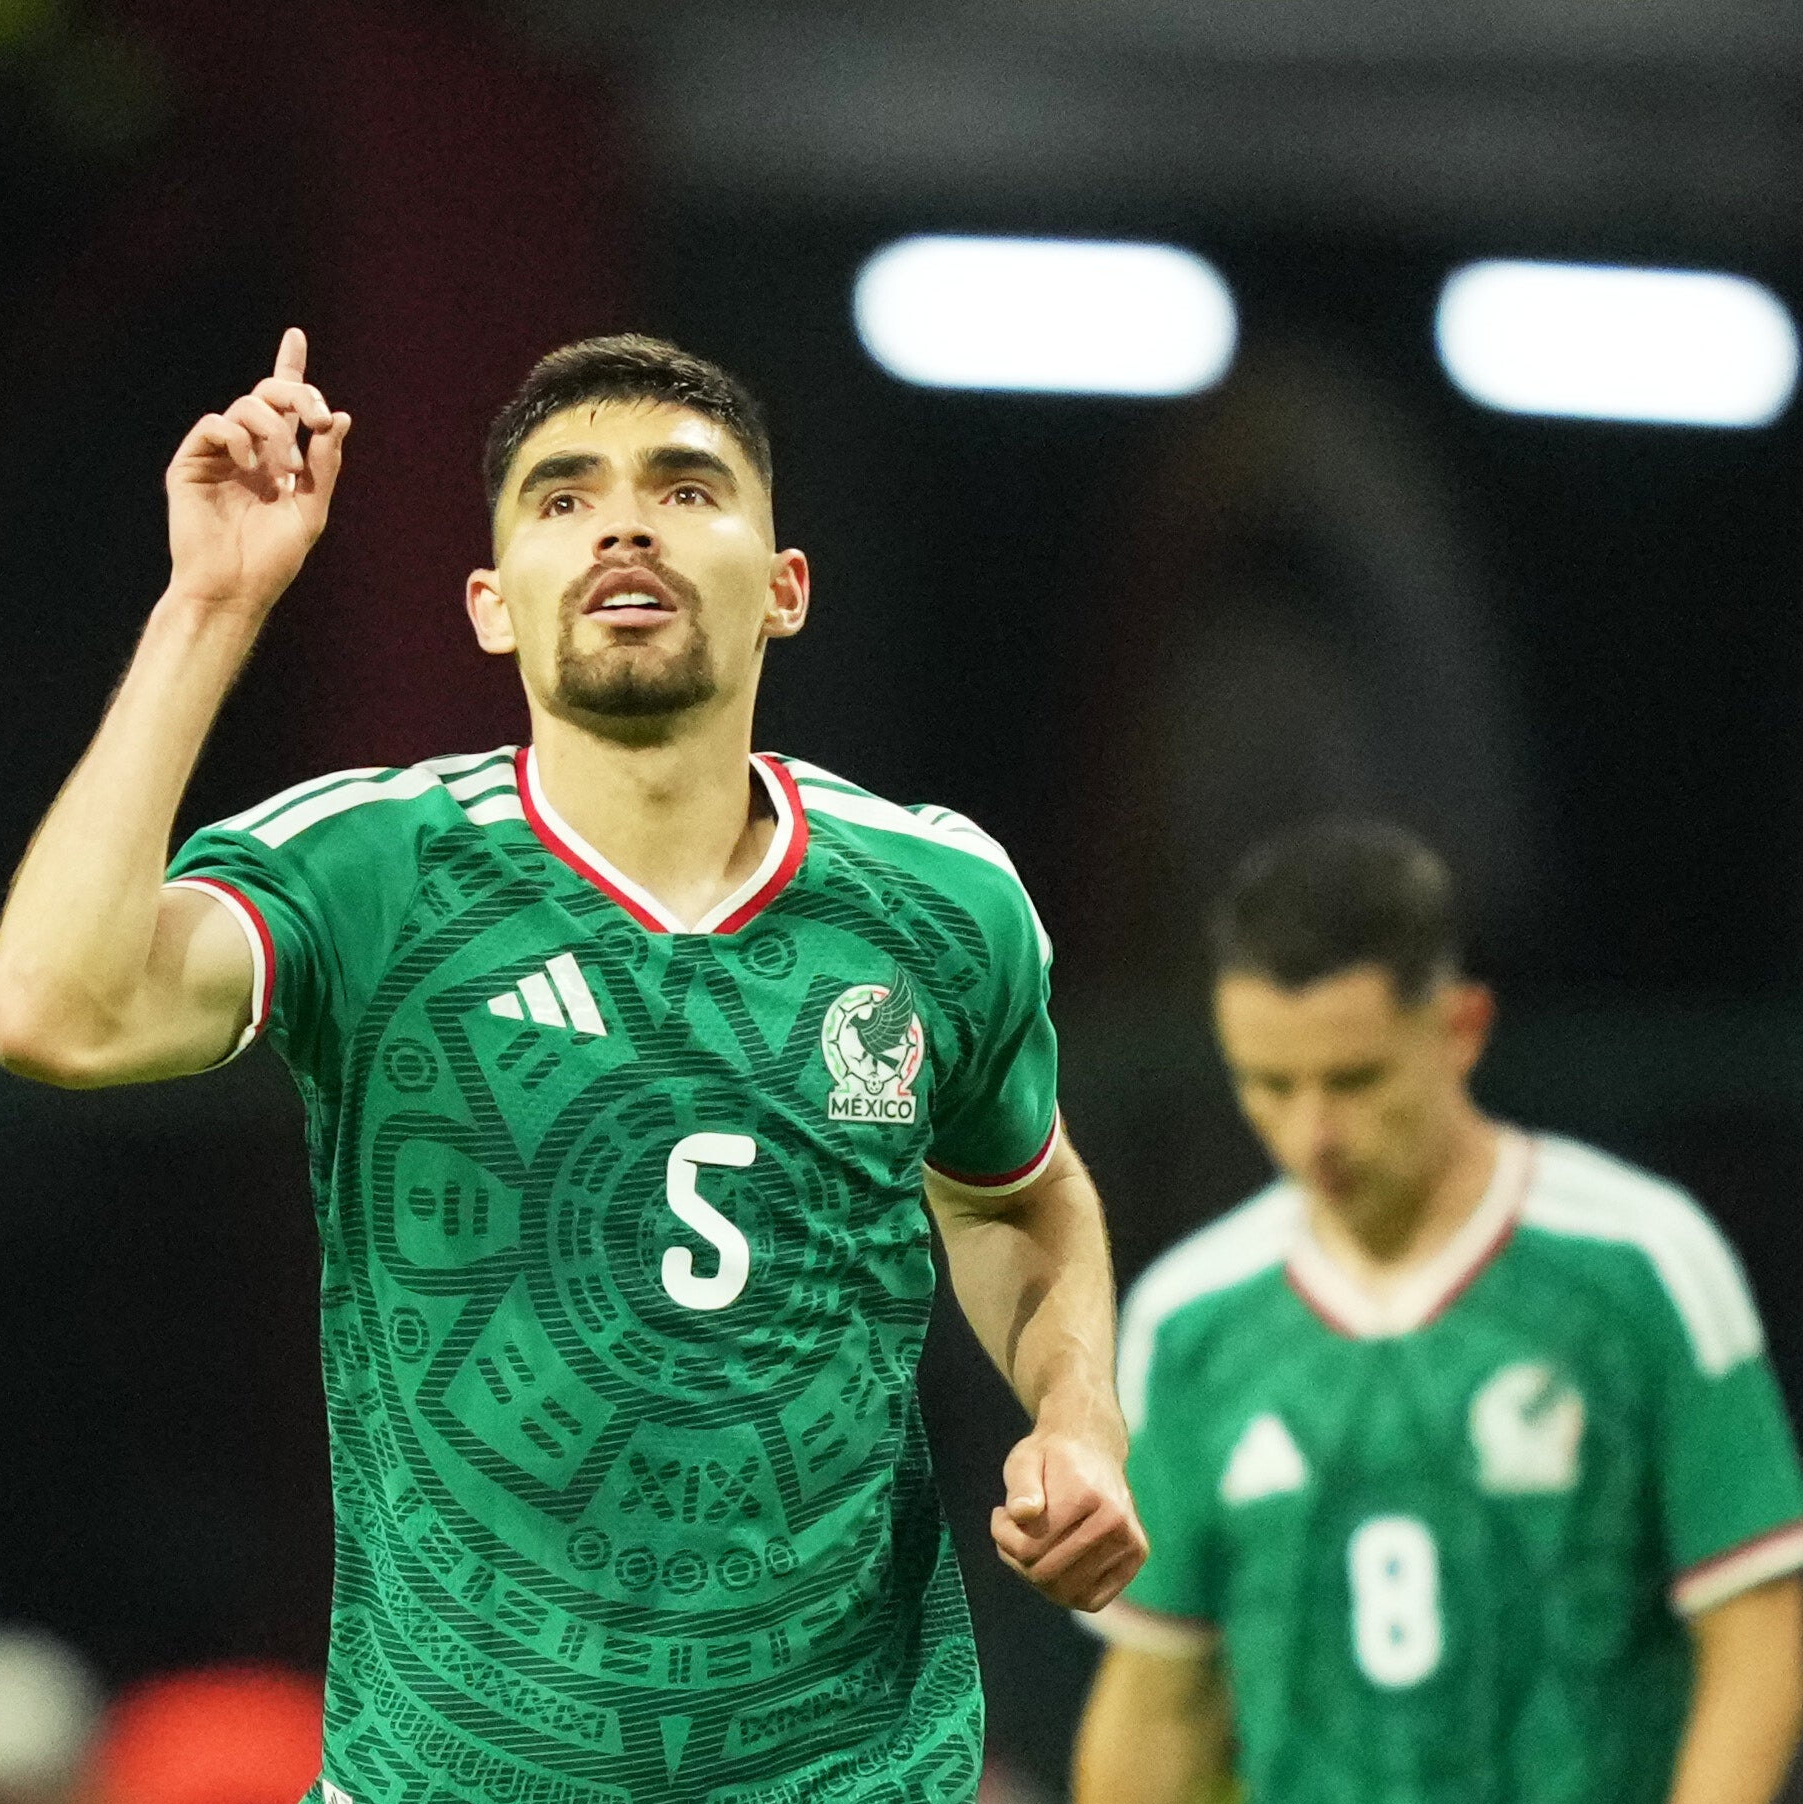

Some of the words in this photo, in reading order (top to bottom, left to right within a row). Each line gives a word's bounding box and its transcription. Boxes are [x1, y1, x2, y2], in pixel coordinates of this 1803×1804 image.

[831, 1093, 912, 1119] MÉXICO
[661, 1132, 757, 1310] 5
[1347, 1514, 1443, 1690] 8
